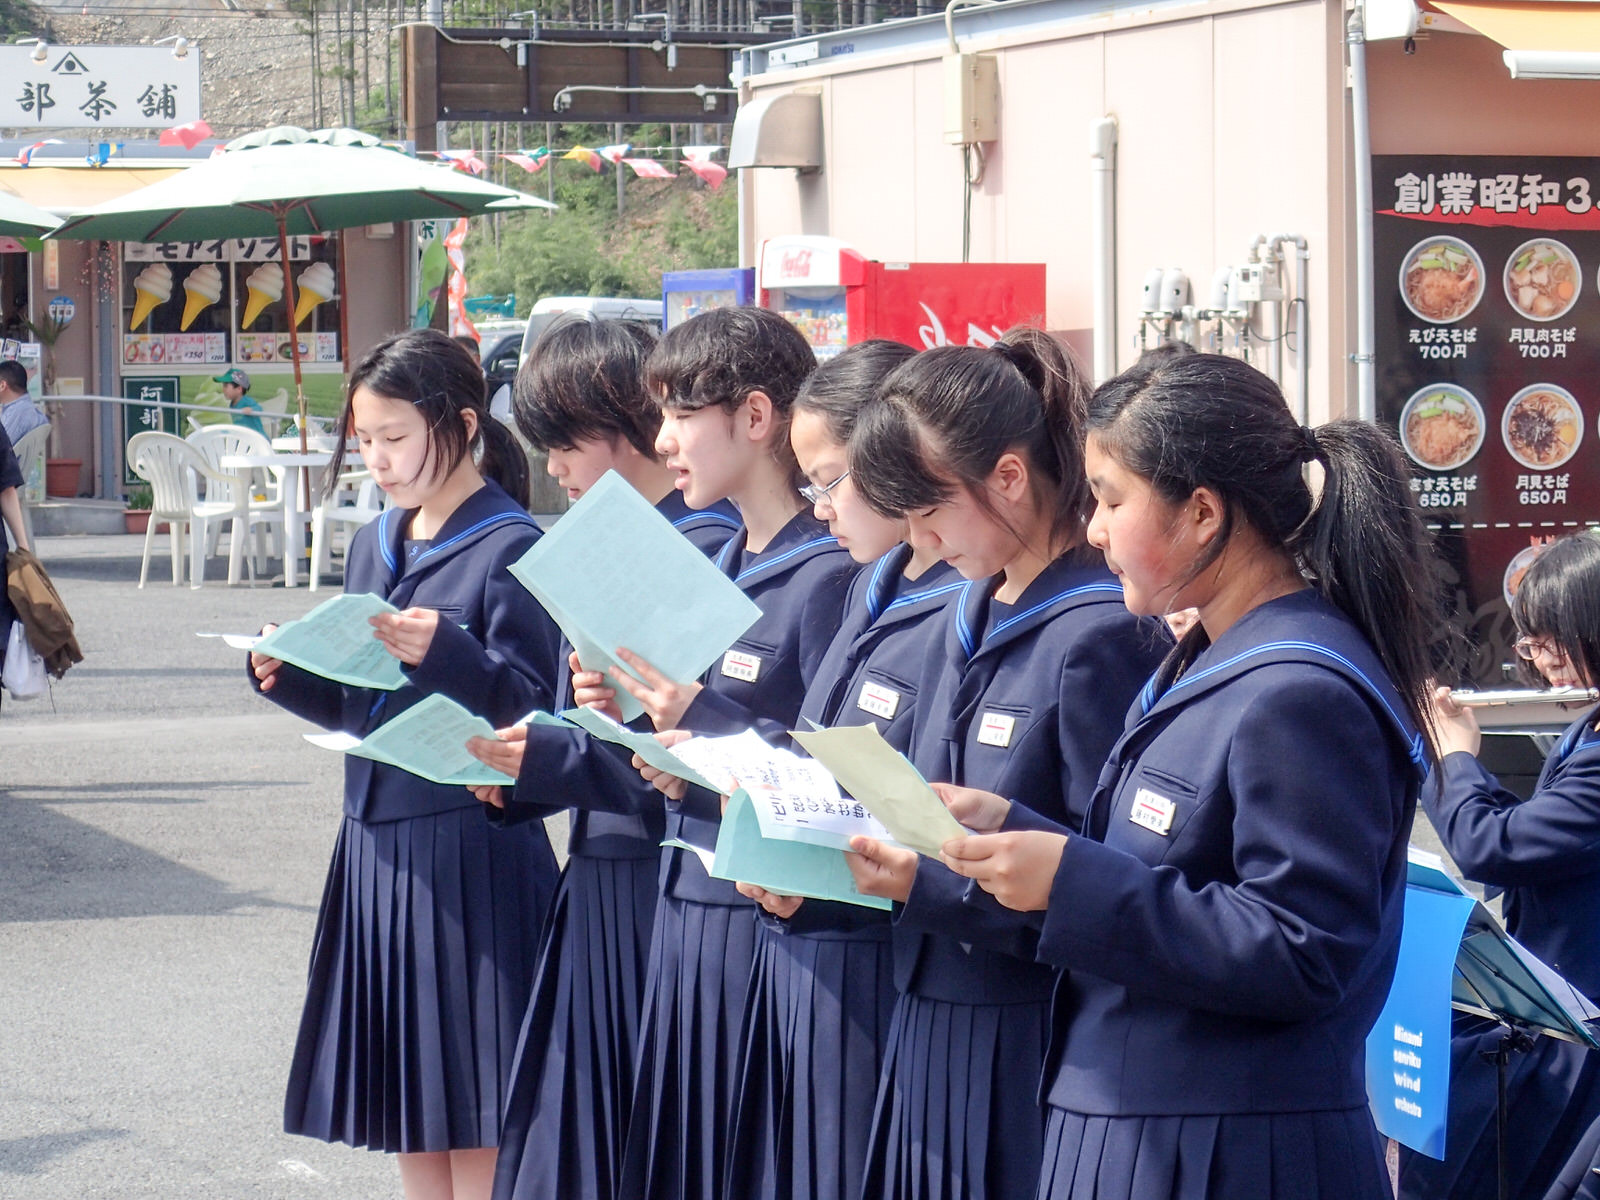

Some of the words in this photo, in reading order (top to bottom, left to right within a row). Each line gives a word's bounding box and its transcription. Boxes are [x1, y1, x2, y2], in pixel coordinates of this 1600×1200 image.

[1394, 172, 1600, 214] 創業昭和3
[1409, 327, 1478, 343] えび天そば
[1509, 327, 1576, 343] 月見肉そば
[1419, 344, 1467, 359] 700円
[1519, 344, 1567, 359] 700円
[1516, 473, 1570, 490] 月見そば
[1419, 492, 1467, 507] 650円
[1519, 490, 1567, 505] 650円
[1393, 1071, 1421, 1093] wind
